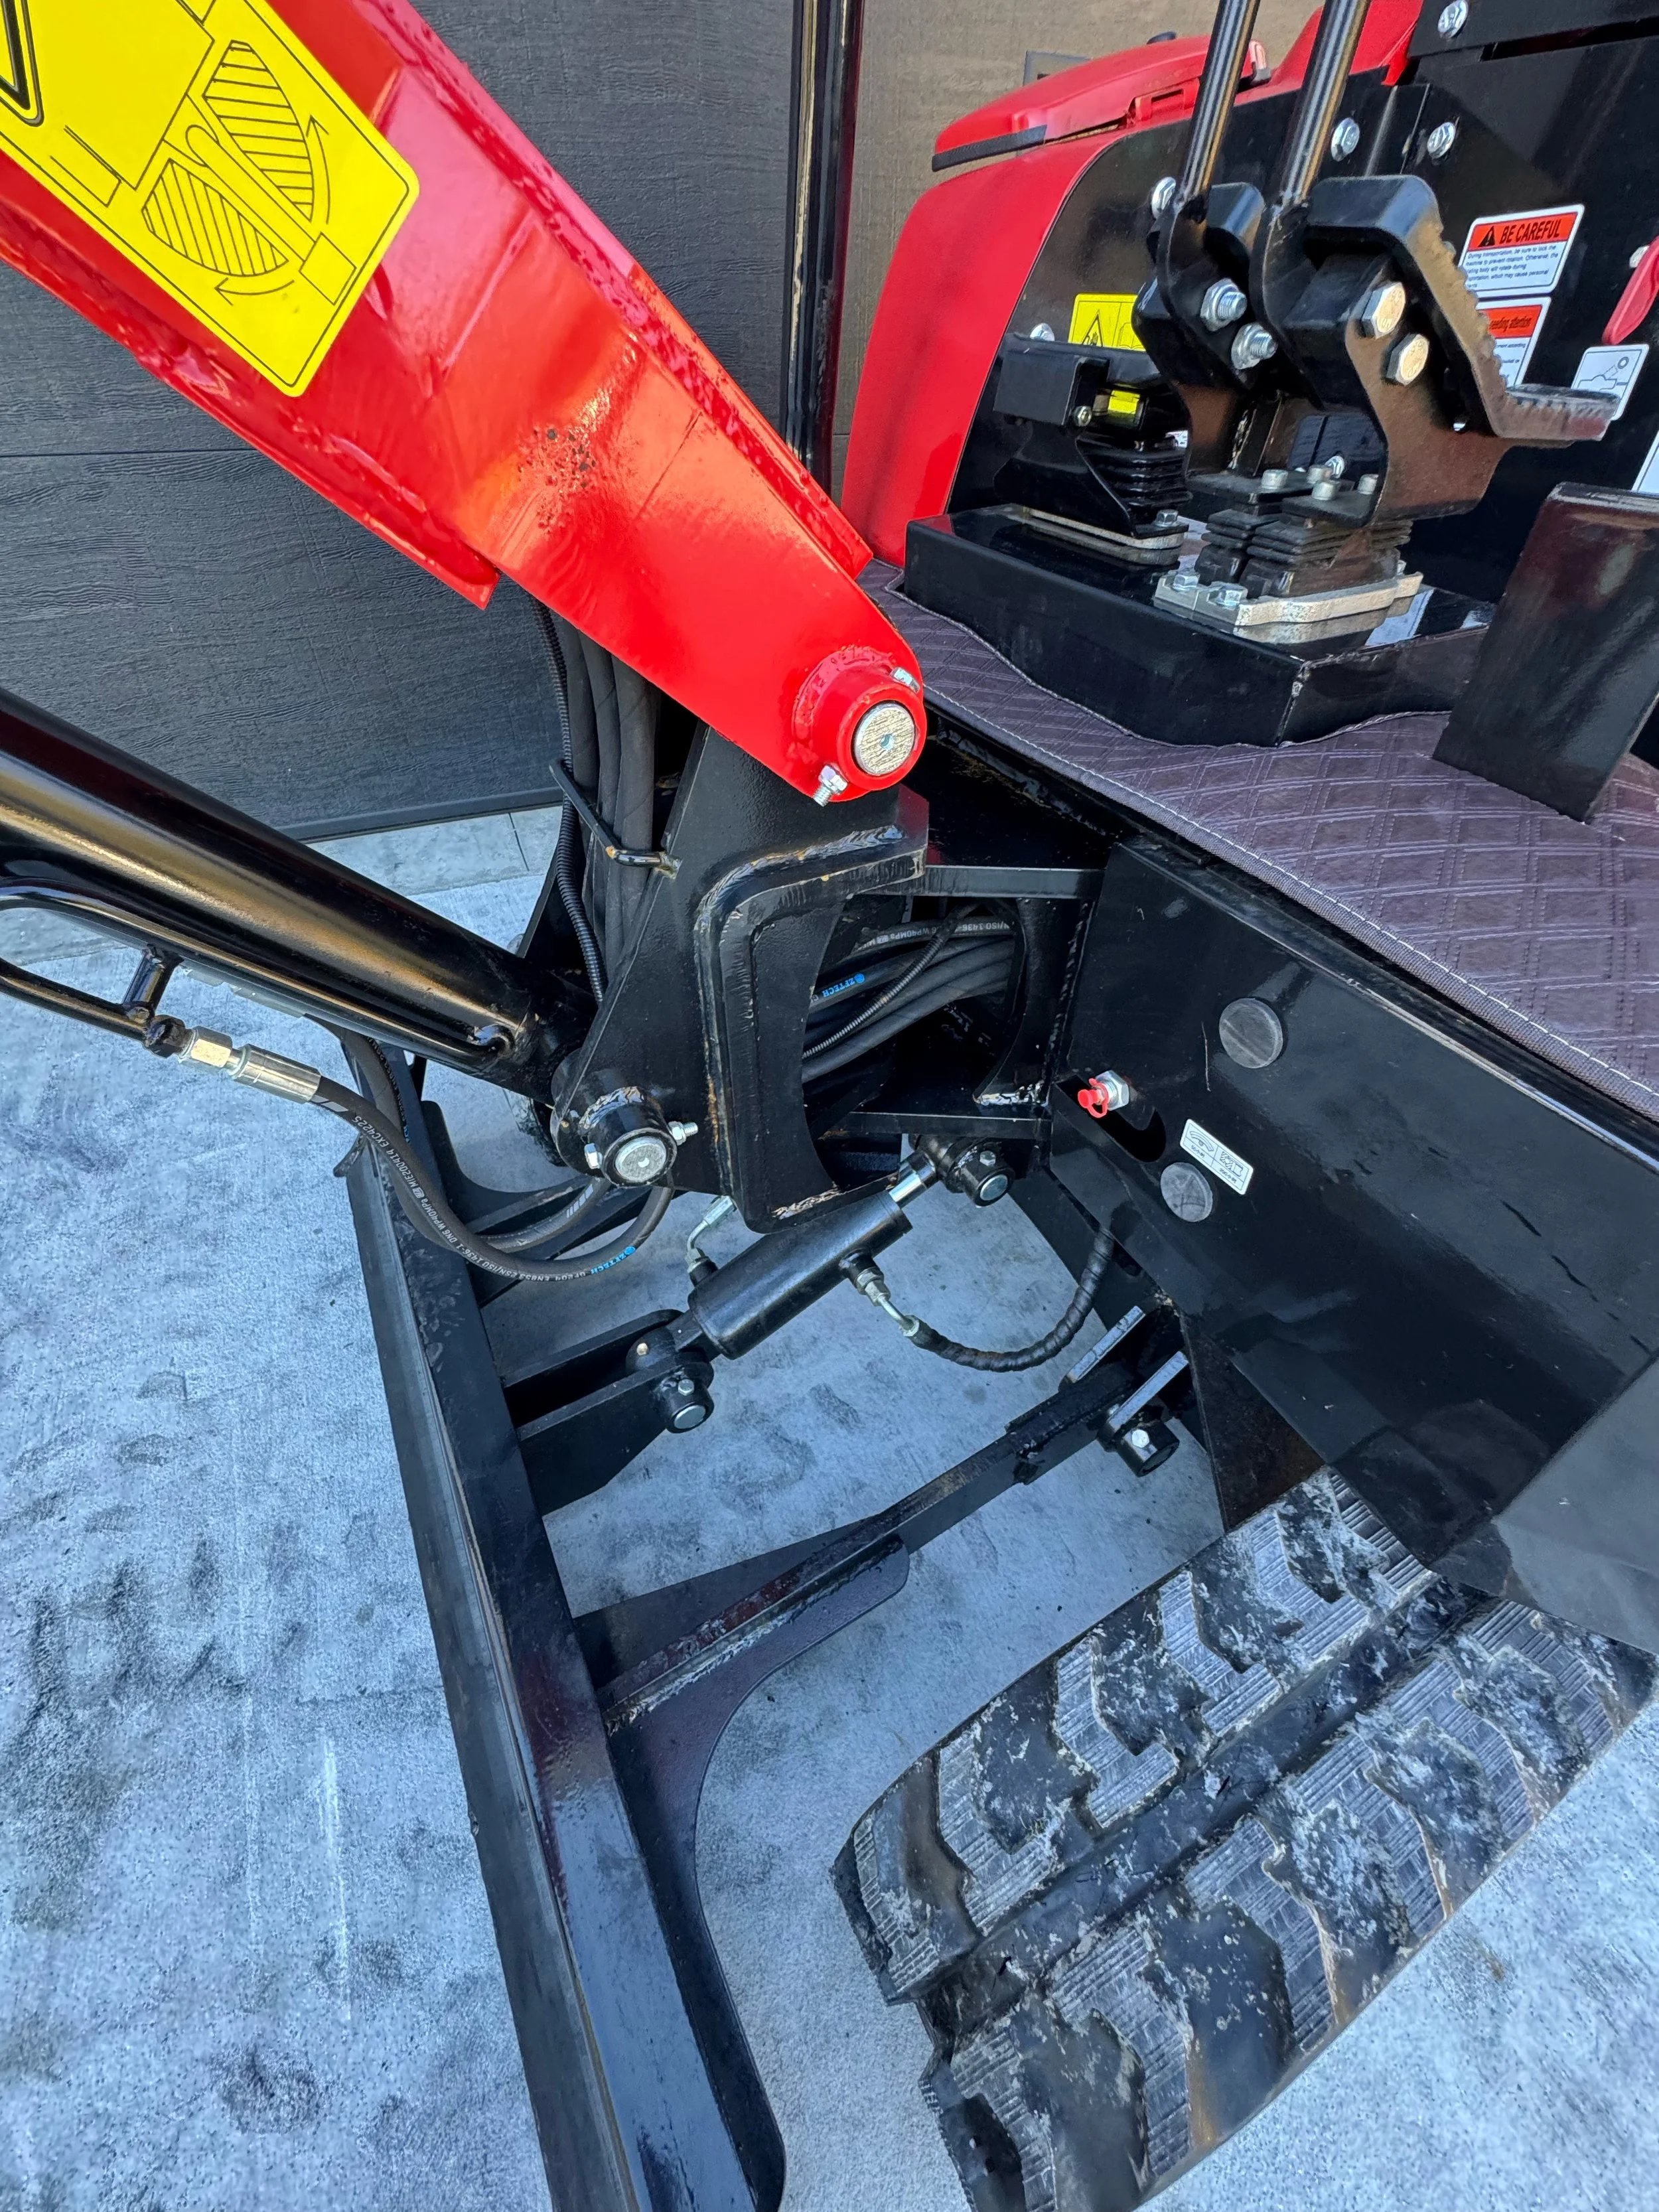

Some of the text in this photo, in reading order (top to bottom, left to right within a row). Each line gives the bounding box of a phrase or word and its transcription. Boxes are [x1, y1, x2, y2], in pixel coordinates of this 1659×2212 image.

[1499, 219, 1562, 244] BE CAREFUL
[890, 926, 930, 940] WP40MPa
[822, 978, 855, 997] ZFTECH
[352, 1116, 390, 1147] EXC4225
[421, 1198, 446, 1230] WP40MPa
[442, 1230, 458, 1243] DN6
[457, 1243, 484, 1264] 1436-1
[591, 1252, 626, 1275] ZFTECH
